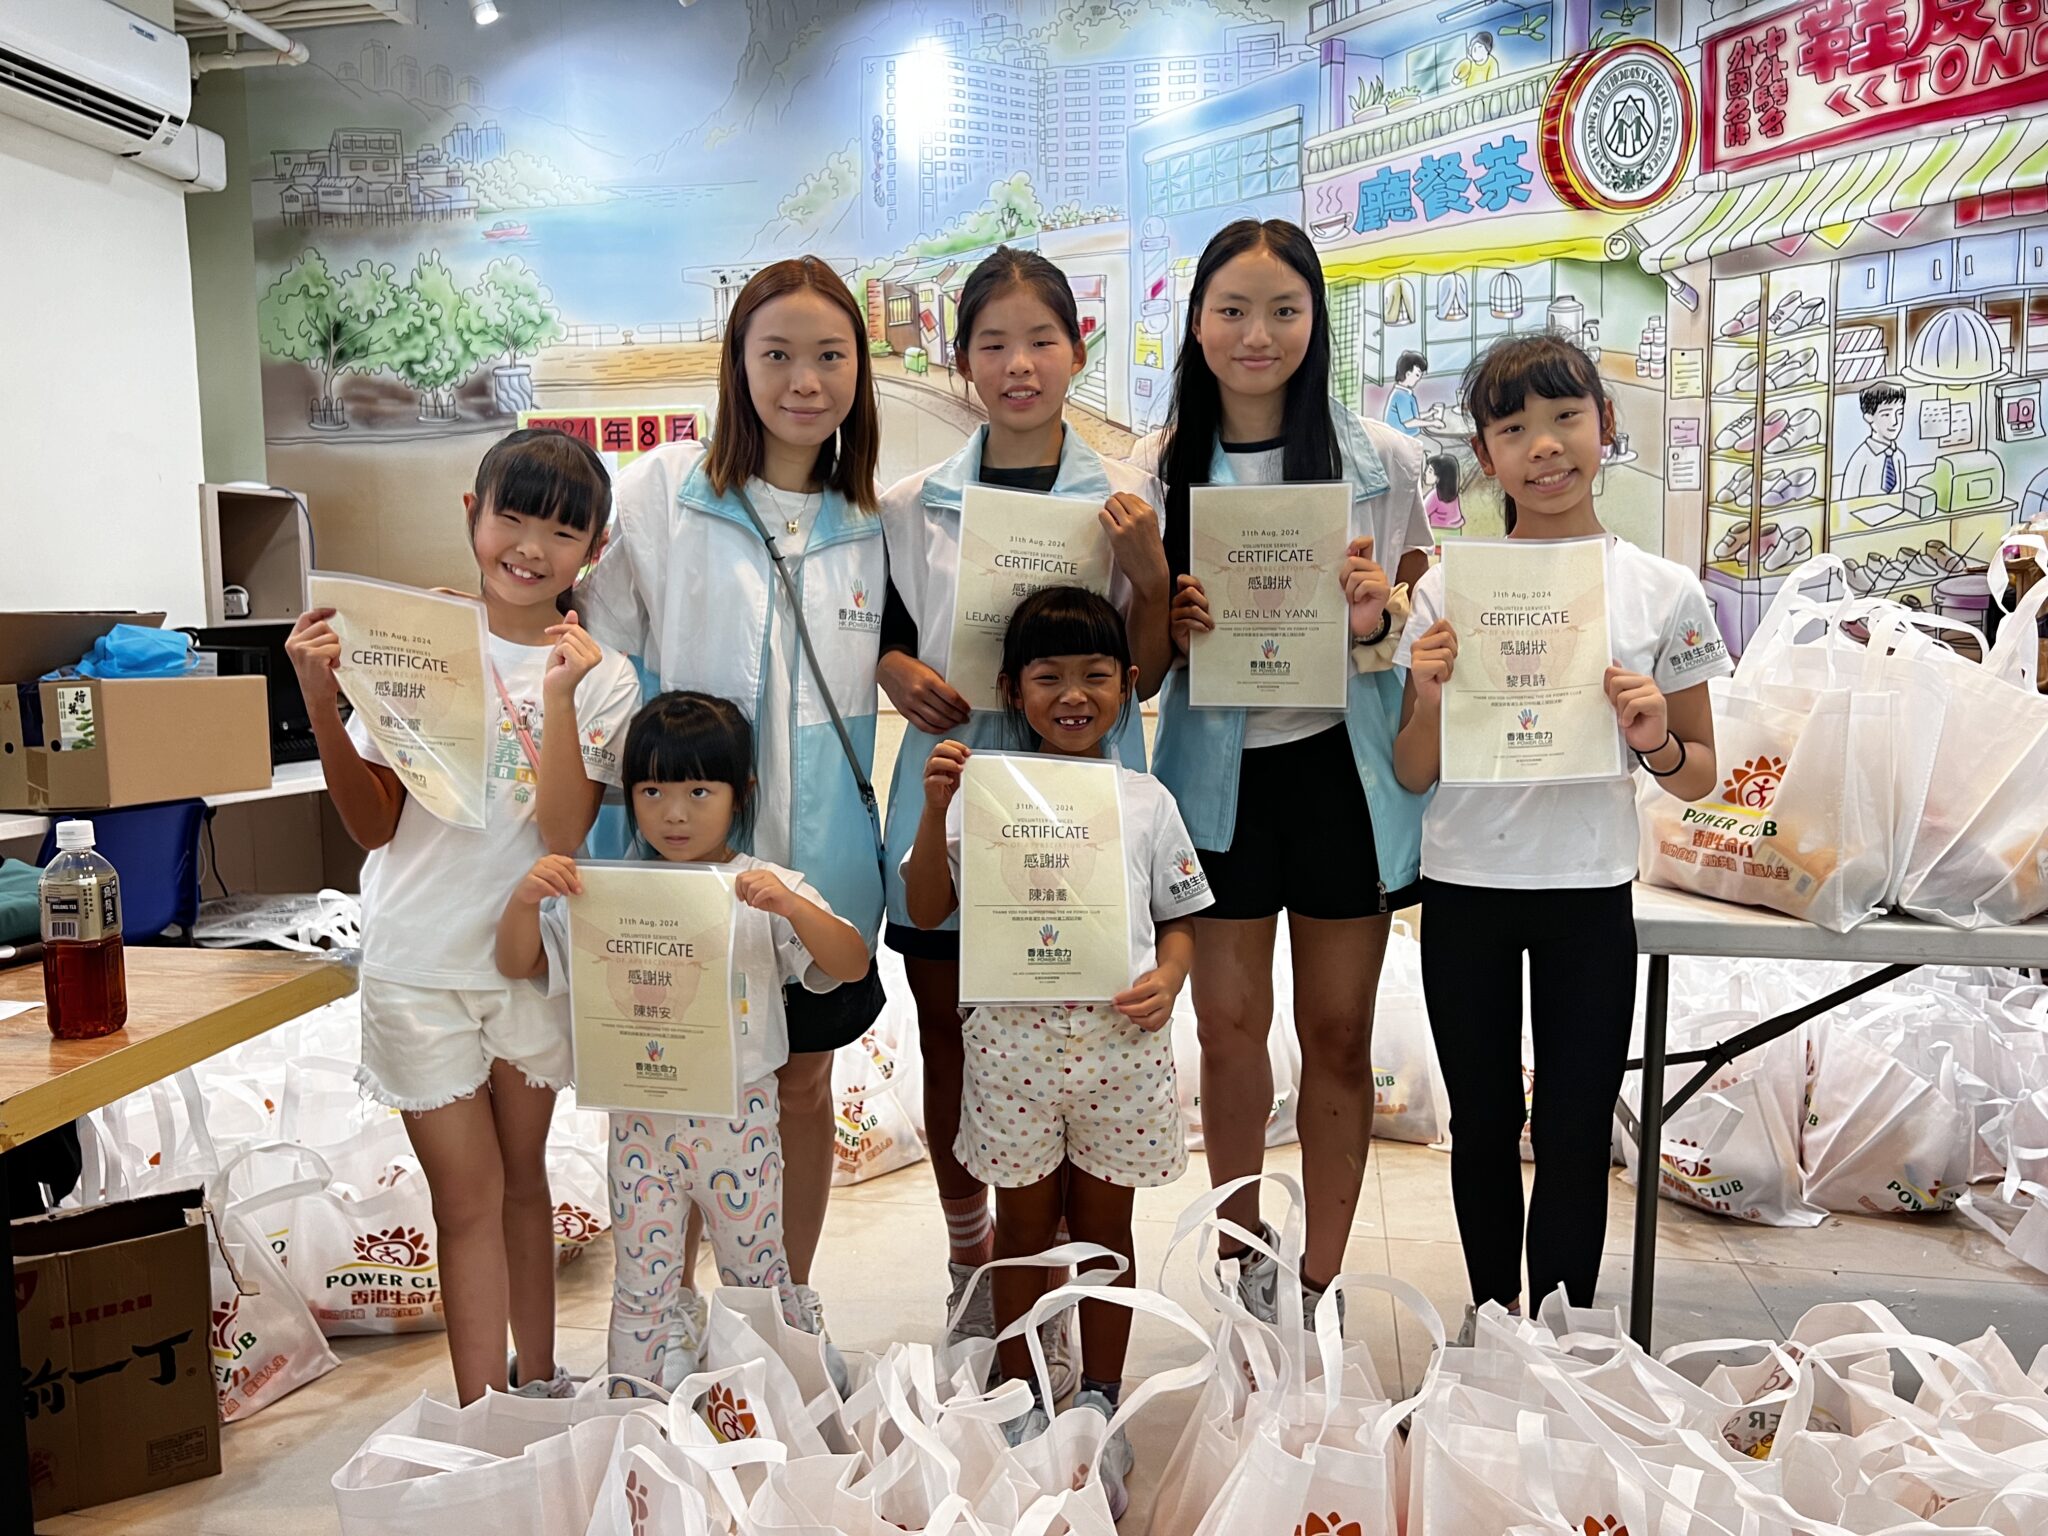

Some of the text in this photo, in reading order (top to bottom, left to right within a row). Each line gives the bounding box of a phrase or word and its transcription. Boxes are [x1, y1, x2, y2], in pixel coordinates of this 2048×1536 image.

[1048, 540, 1065, 548] 2024
[1227, 549, 1314, 563] CERTIFICATE
[995, 554, 1078, 575] CERTIFICATE
[1248, 575, 1292, 590] 感謝狀
[966, 611, 1000, 624] LEUNG
[1223, 610, 1318, 618] BAI EN LIN YANNI
[1480, 610, 1570, 626] CERTIFICATE
[412, 637, 432, 645] 2024
[1500, 640, 1547, 656] 感謝狀
[351, 650, 449, 673] CERTIFICATE
[1250, 660, 1291, 669] 香港生命力
[1506, 674, 1546, 688] 黎貝詩
[375, 681, 426, 699] 感謝狀
[1507, 731, 1553, 741] 香港生命力
[1682, 808, 1738, 831] POWER
[1002, 825, 1090, 839] CERTIFICATE
[1024, 853, 1070, 868] 感謝狀
[660, 919, 679, 927] 2024
[606, 940, 694, 958] CERTIFICATE
[1028, 948, 1071, 957] 香港生命力
[628, 970, 672, 987] 感謝狀
[636, 1062, 677, 1074] 香港生命力
[1697, 1180, 1744, 1198] CLUB
[326, 1273, 403, 1288] POWER
